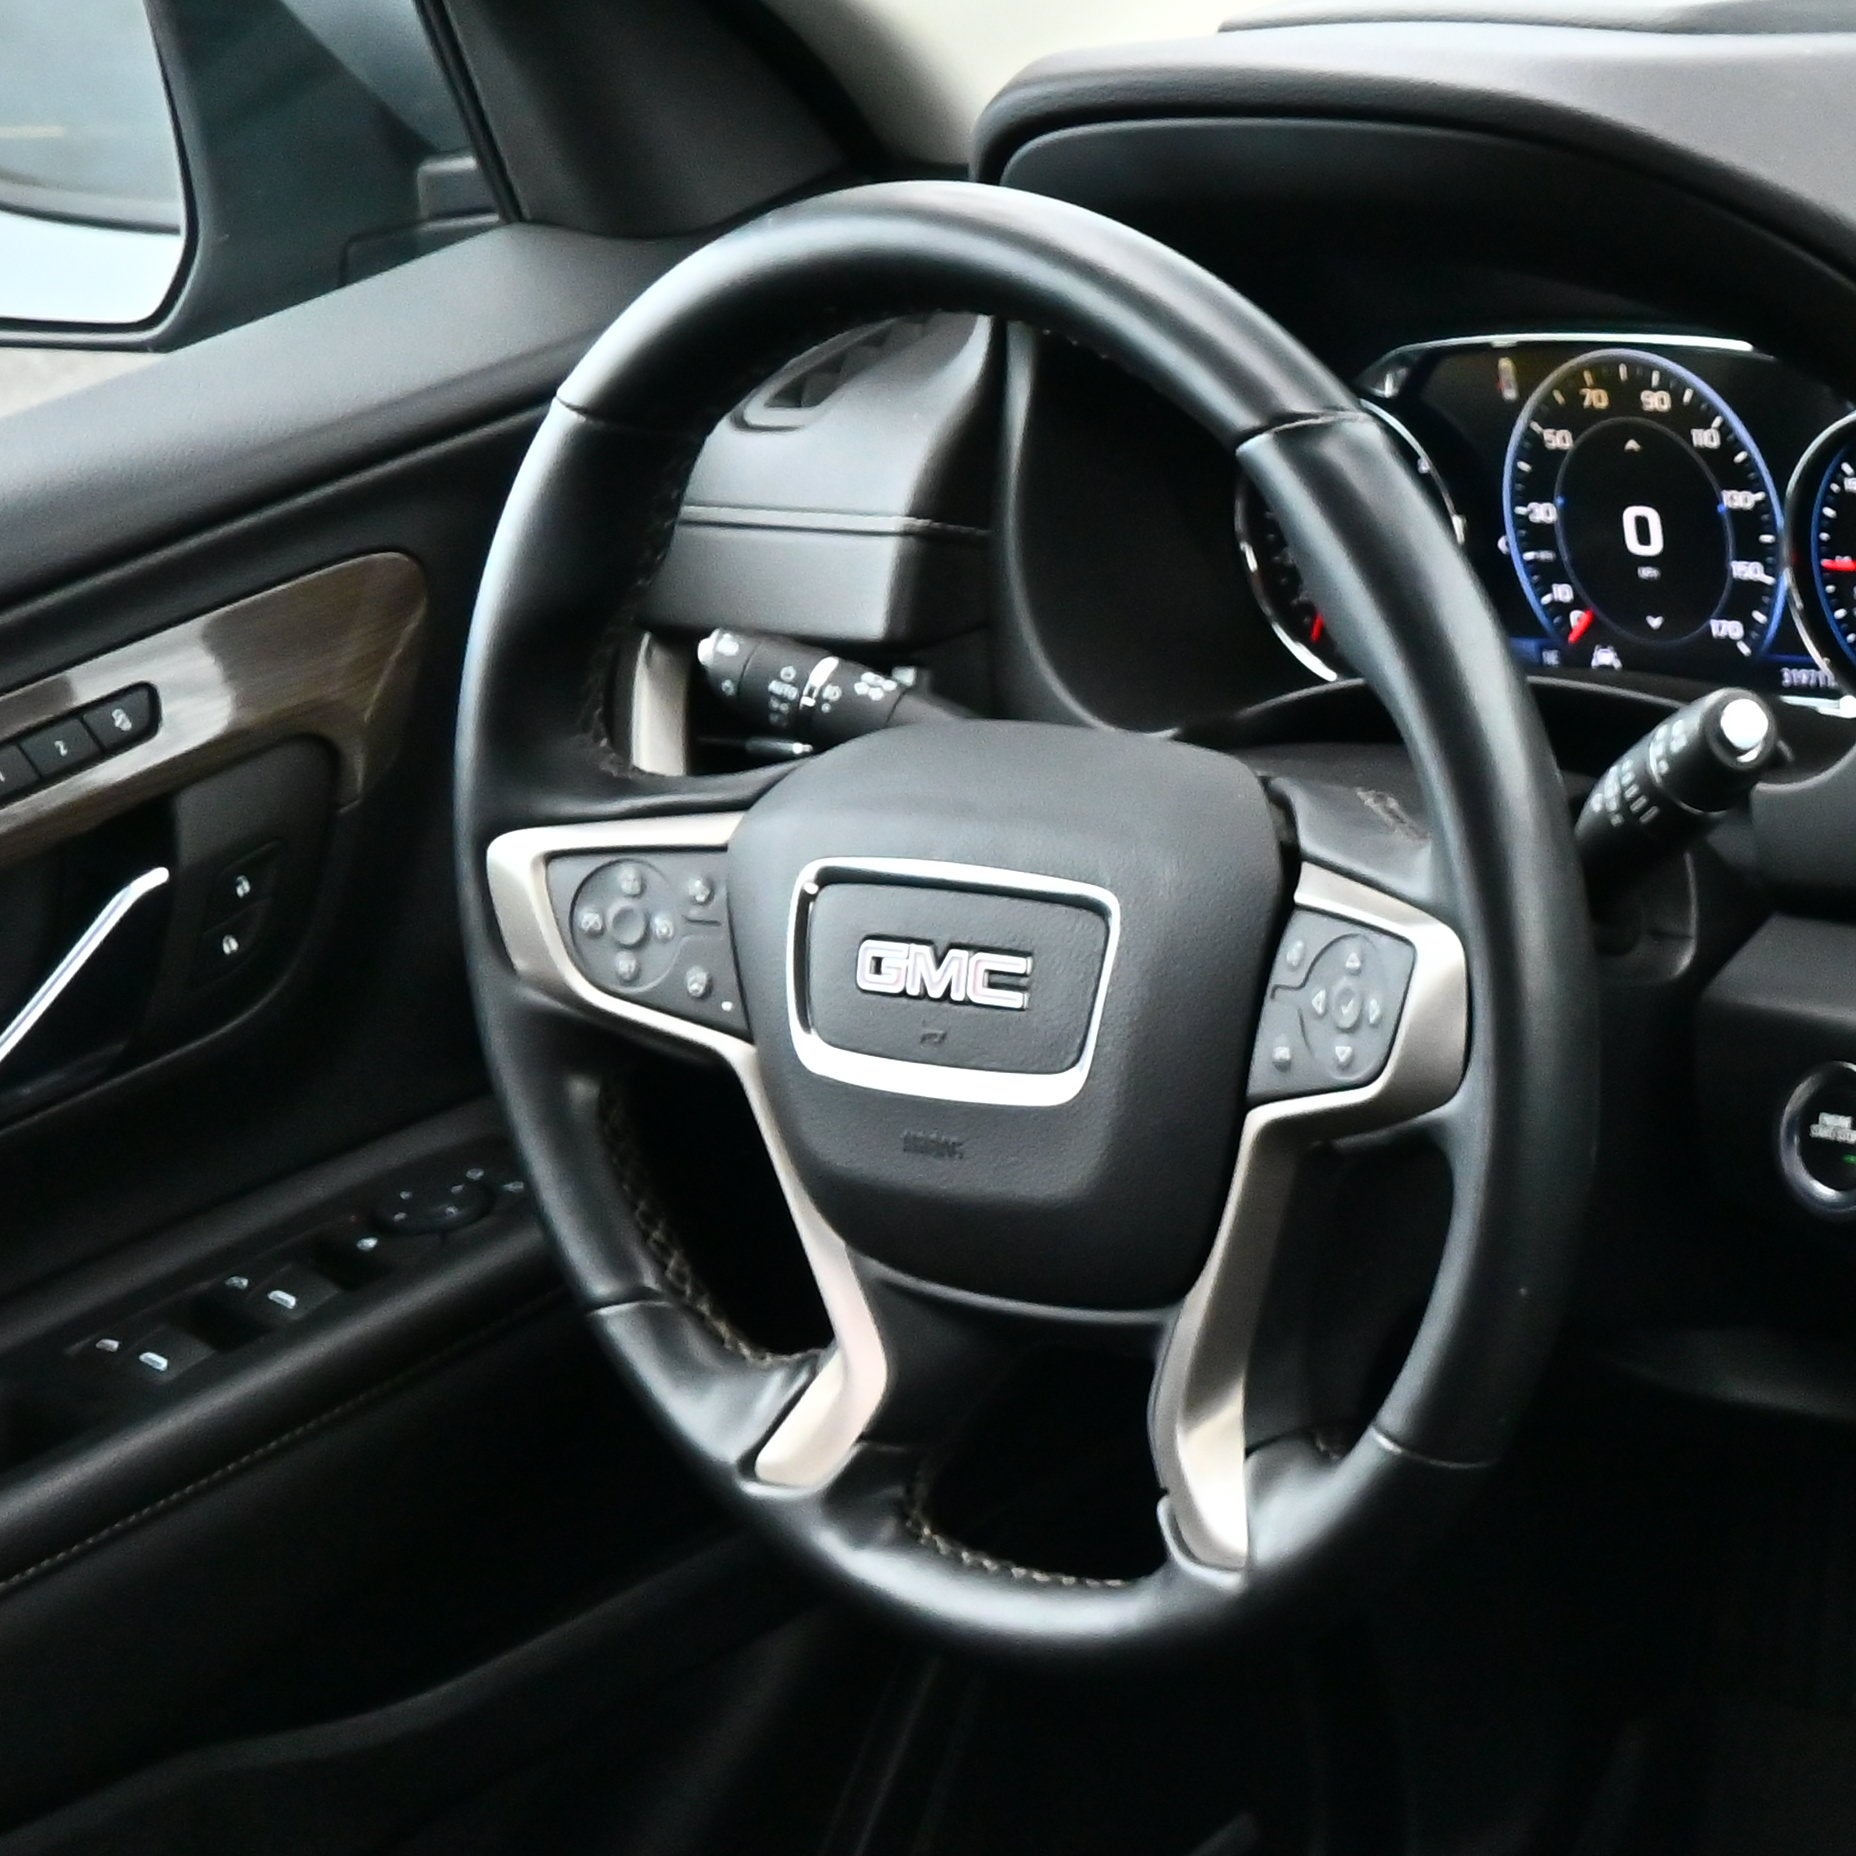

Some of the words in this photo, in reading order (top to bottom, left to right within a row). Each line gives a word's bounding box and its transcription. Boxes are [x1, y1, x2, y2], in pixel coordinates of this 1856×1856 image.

[1579, 388, 1609, 410] 70
[1640, 390, 1671, 412] 90
[1543, 428, 1573, 450] 50
[1690, 428, 1721, 449] 110
[1527, 502, 1558, 524] 30
[1622, 505, 1664, 557] 0
[1710, 619, 1744, 640] 170
[856, 938, 1032, 1011] GMC
